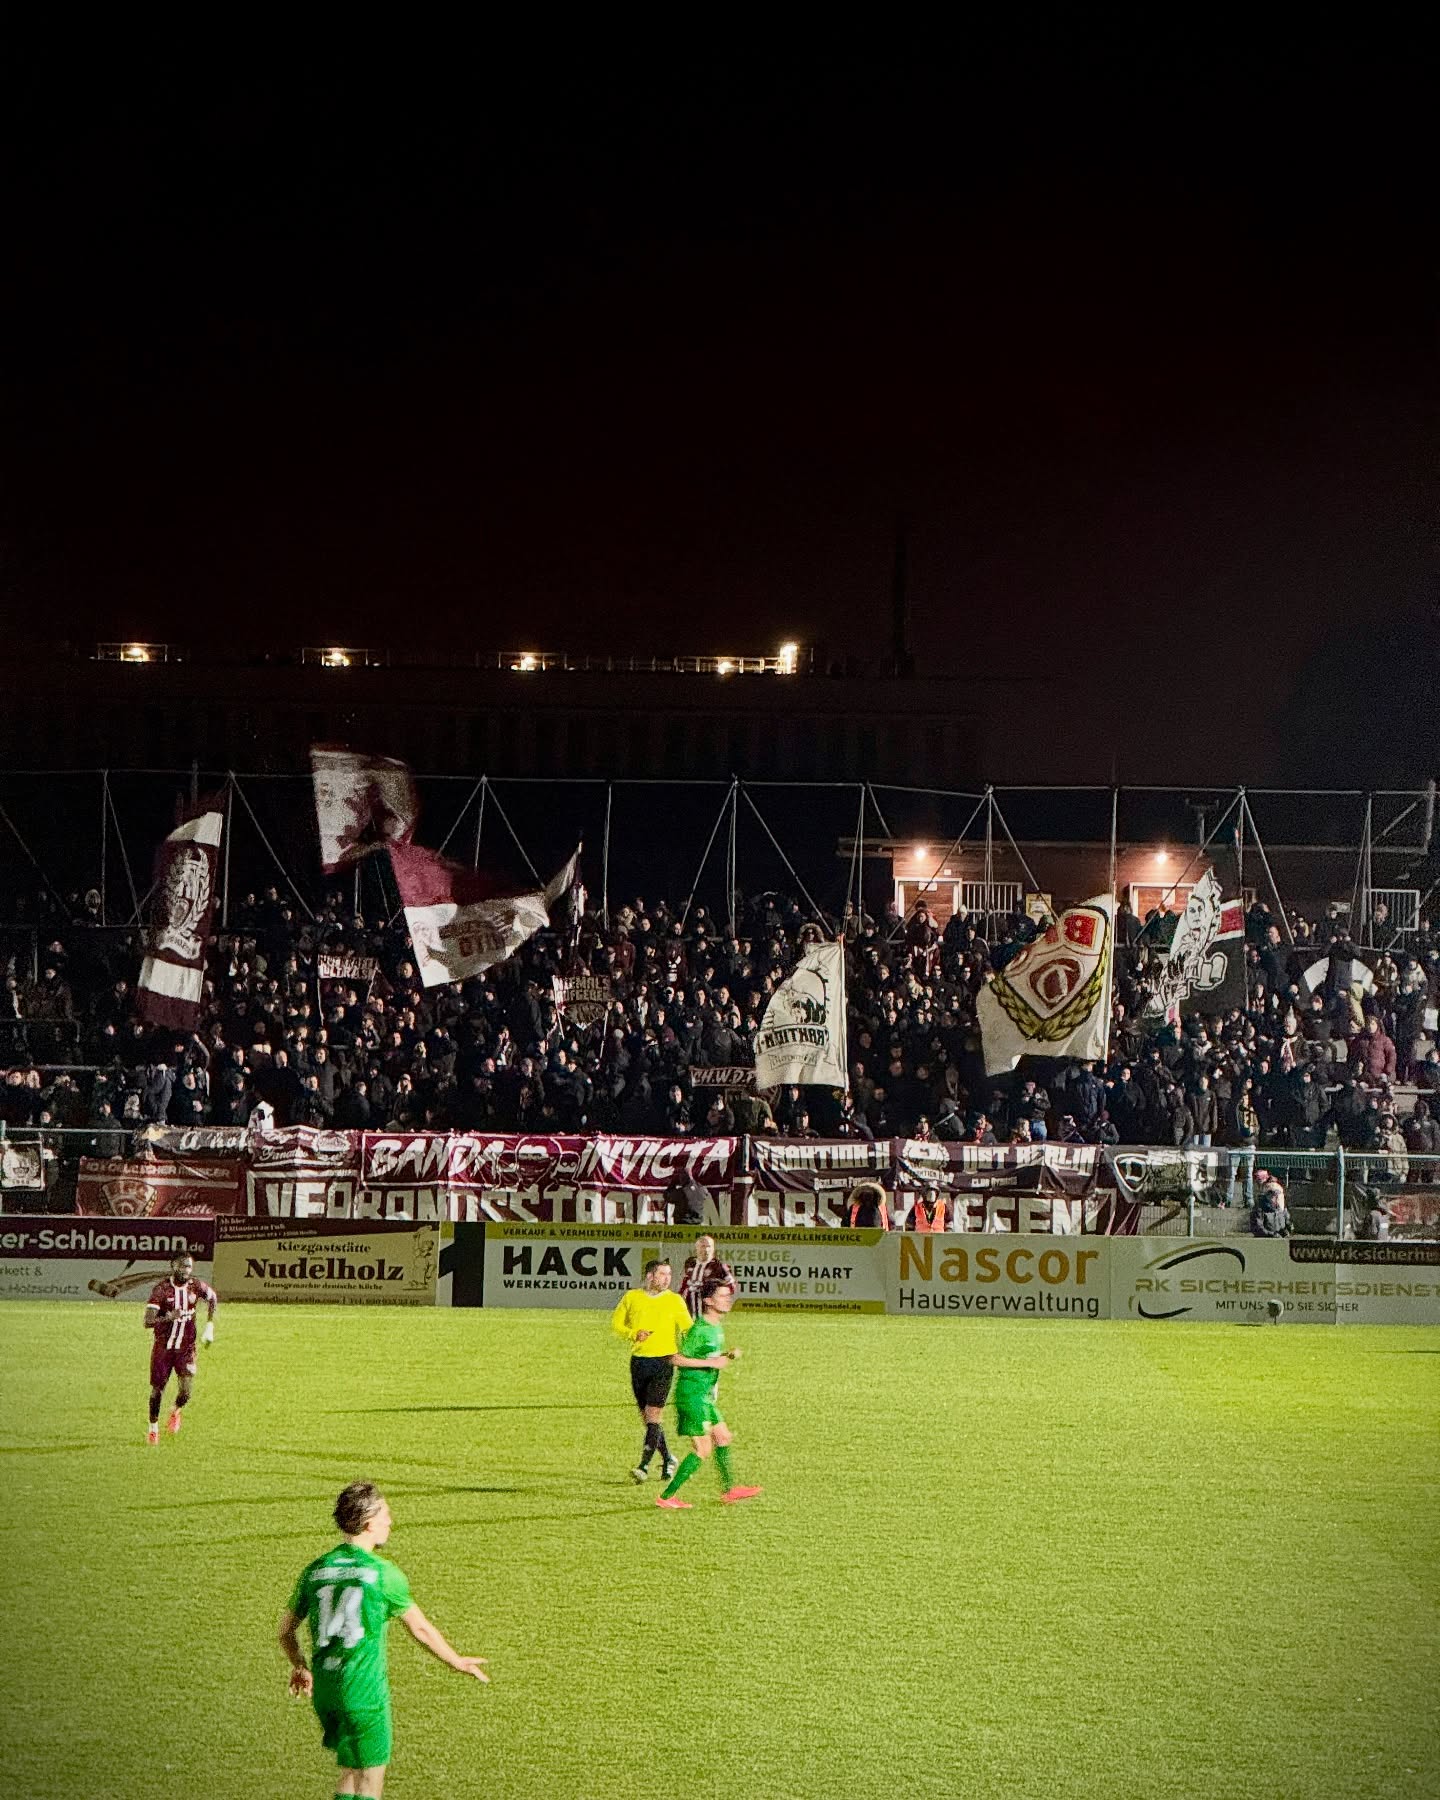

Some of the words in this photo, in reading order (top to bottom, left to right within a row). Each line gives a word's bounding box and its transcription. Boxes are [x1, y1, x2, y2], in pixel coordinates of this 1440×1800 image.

[367, 1138, 504, 1179] BANDA
[576, 1139, 730, 1180] INVICTA
[0, 1229, 205, 1253] er-Schlomann.de
[503, 1228, 546, 1237] VERKAUF
[560, 1228, 622, 1238] VERMIETUNG
[633, 1230, 684, 1239] BERATUNG
[761, 1233, 861, 1242] BAUSTELLENSERVICE
[277, 1241, 372, 1255] Kiezgaststätte
[503, 1245, 632, 1277] HACK
[900, 1236, 1099, 1285] Nascor
[244, 1257, 404, 1281] Nudelholz
[808, 1267, 853, 1280] HART
[503, 1279, 632, 1290] WERKZEUGHANDEL
[776, 1282, 809, 1295] WIE
[815, 1283, 842, 1295] DU.
[1135, 1278, 1169, 1292] RK
[742, 1302, 861, 1311] www.hack-werkzeughandel.de
[899, 1288, 1099, 1318] Hausverwaltung
[1216, 1300, 1237, 1309] MIT
[1239, 1301, 1263, 1311] UNS
[1291, 1302, 1314, 1311] SIE
[1317, 1302, 1359, 1312] SICHER
[316, 1585, 365, 1649] 14
